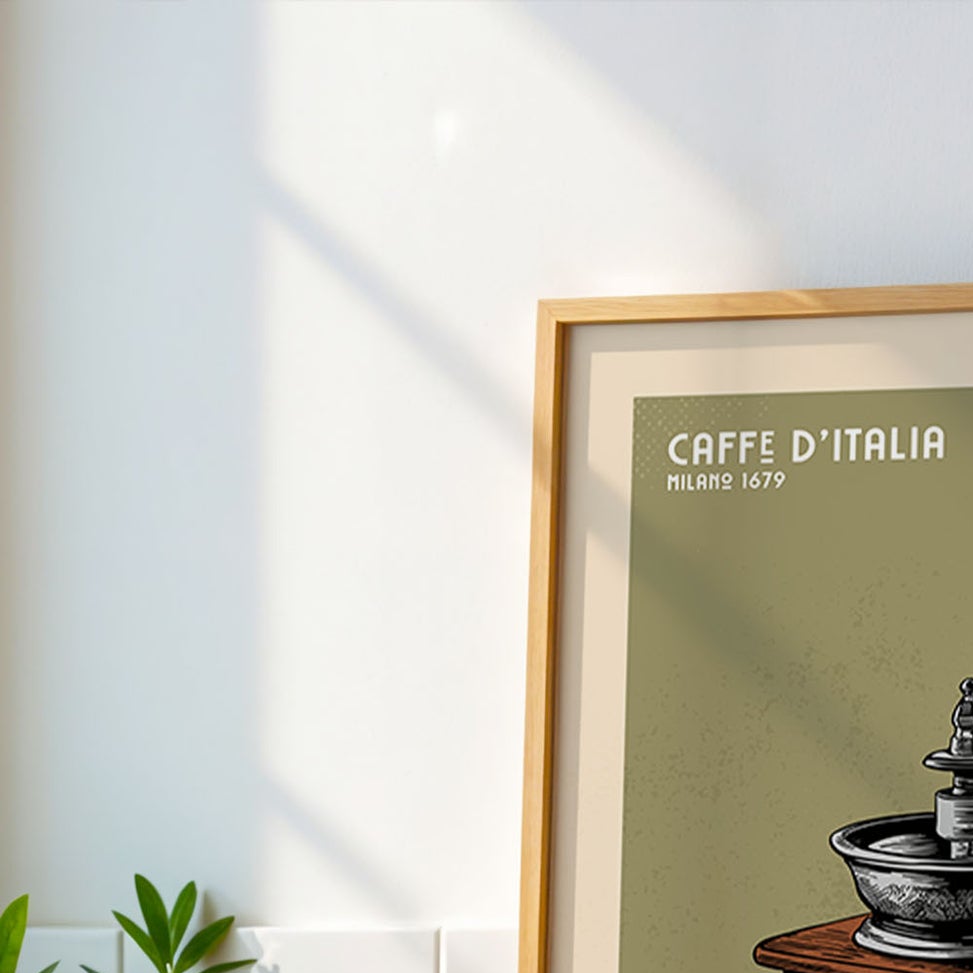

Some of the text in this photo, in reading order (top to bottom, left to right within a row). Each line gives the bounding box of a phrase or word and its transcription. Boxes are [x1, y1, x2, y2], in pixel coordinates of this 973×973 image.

[668, 426, 946, 466] CAFFE D'ITALIA
[667, 471, 787, 492] MILANO 1679
